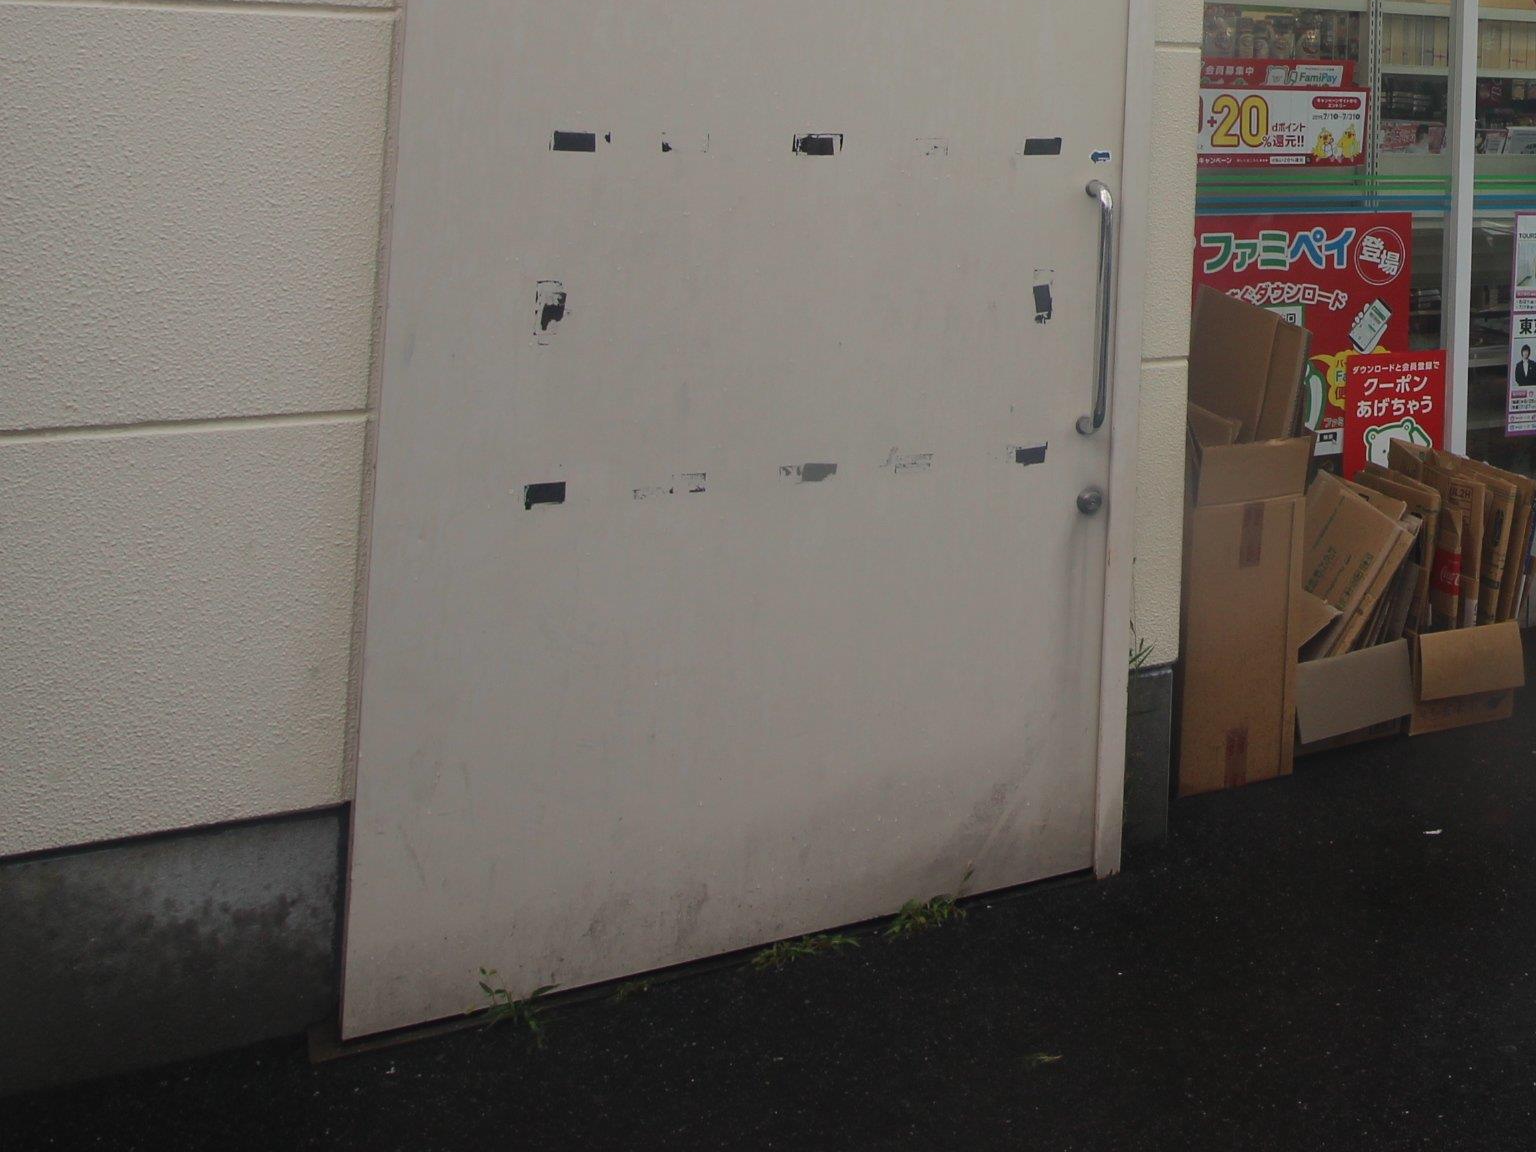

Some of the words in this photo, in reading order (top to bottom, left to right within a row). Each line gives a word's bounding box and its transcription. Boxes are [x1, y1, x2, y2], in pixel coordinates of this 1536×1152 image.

[1299, 71, 1338, 83] FamiPay
[1271, 123, 1307, 132] dポイント
[1201, 228, 1356, 274] ファミペイ
[1358, 235, 1401, 276] 登場
[1352, 361, 1440, 375] ダウンロードと会員登録で
[1363, 375, 1428, 396] クーポン
[1356, 395, 1433, 418] あげちゃう
